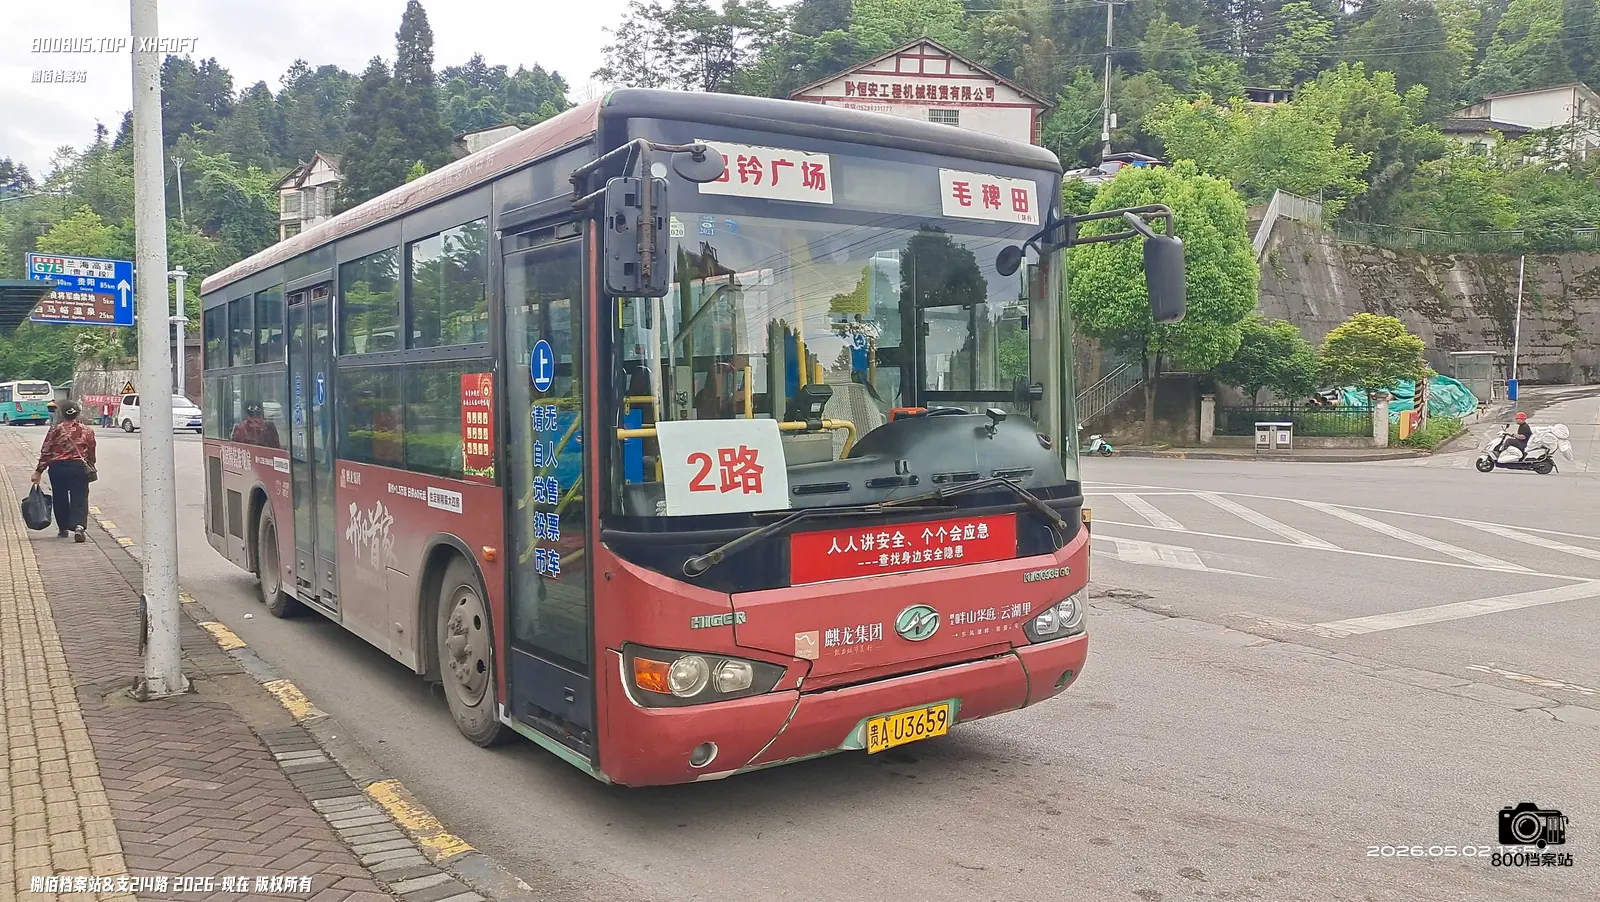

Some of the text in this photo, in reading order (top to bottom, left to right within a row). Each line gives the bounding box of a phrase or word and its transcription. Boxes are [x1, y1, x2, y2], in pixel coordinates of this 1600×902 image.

[952, 181, 1029, 213] 毛稗田
[35, 263, 63, 273] G75
[66, 260, 114, 271] 兰海高速
[98, 311, 115, 320] 25km
[535, 348, 551, 383] 上
[687, 445, 765, 495] 2路
[544, 404, 560, 578] 无人售票车
[827, 522, 990, 555] 人人讲安全、个个会应急
[690, 611, 747, 629] HIGER
[824, 622, 883, 648] 麒龙集团
